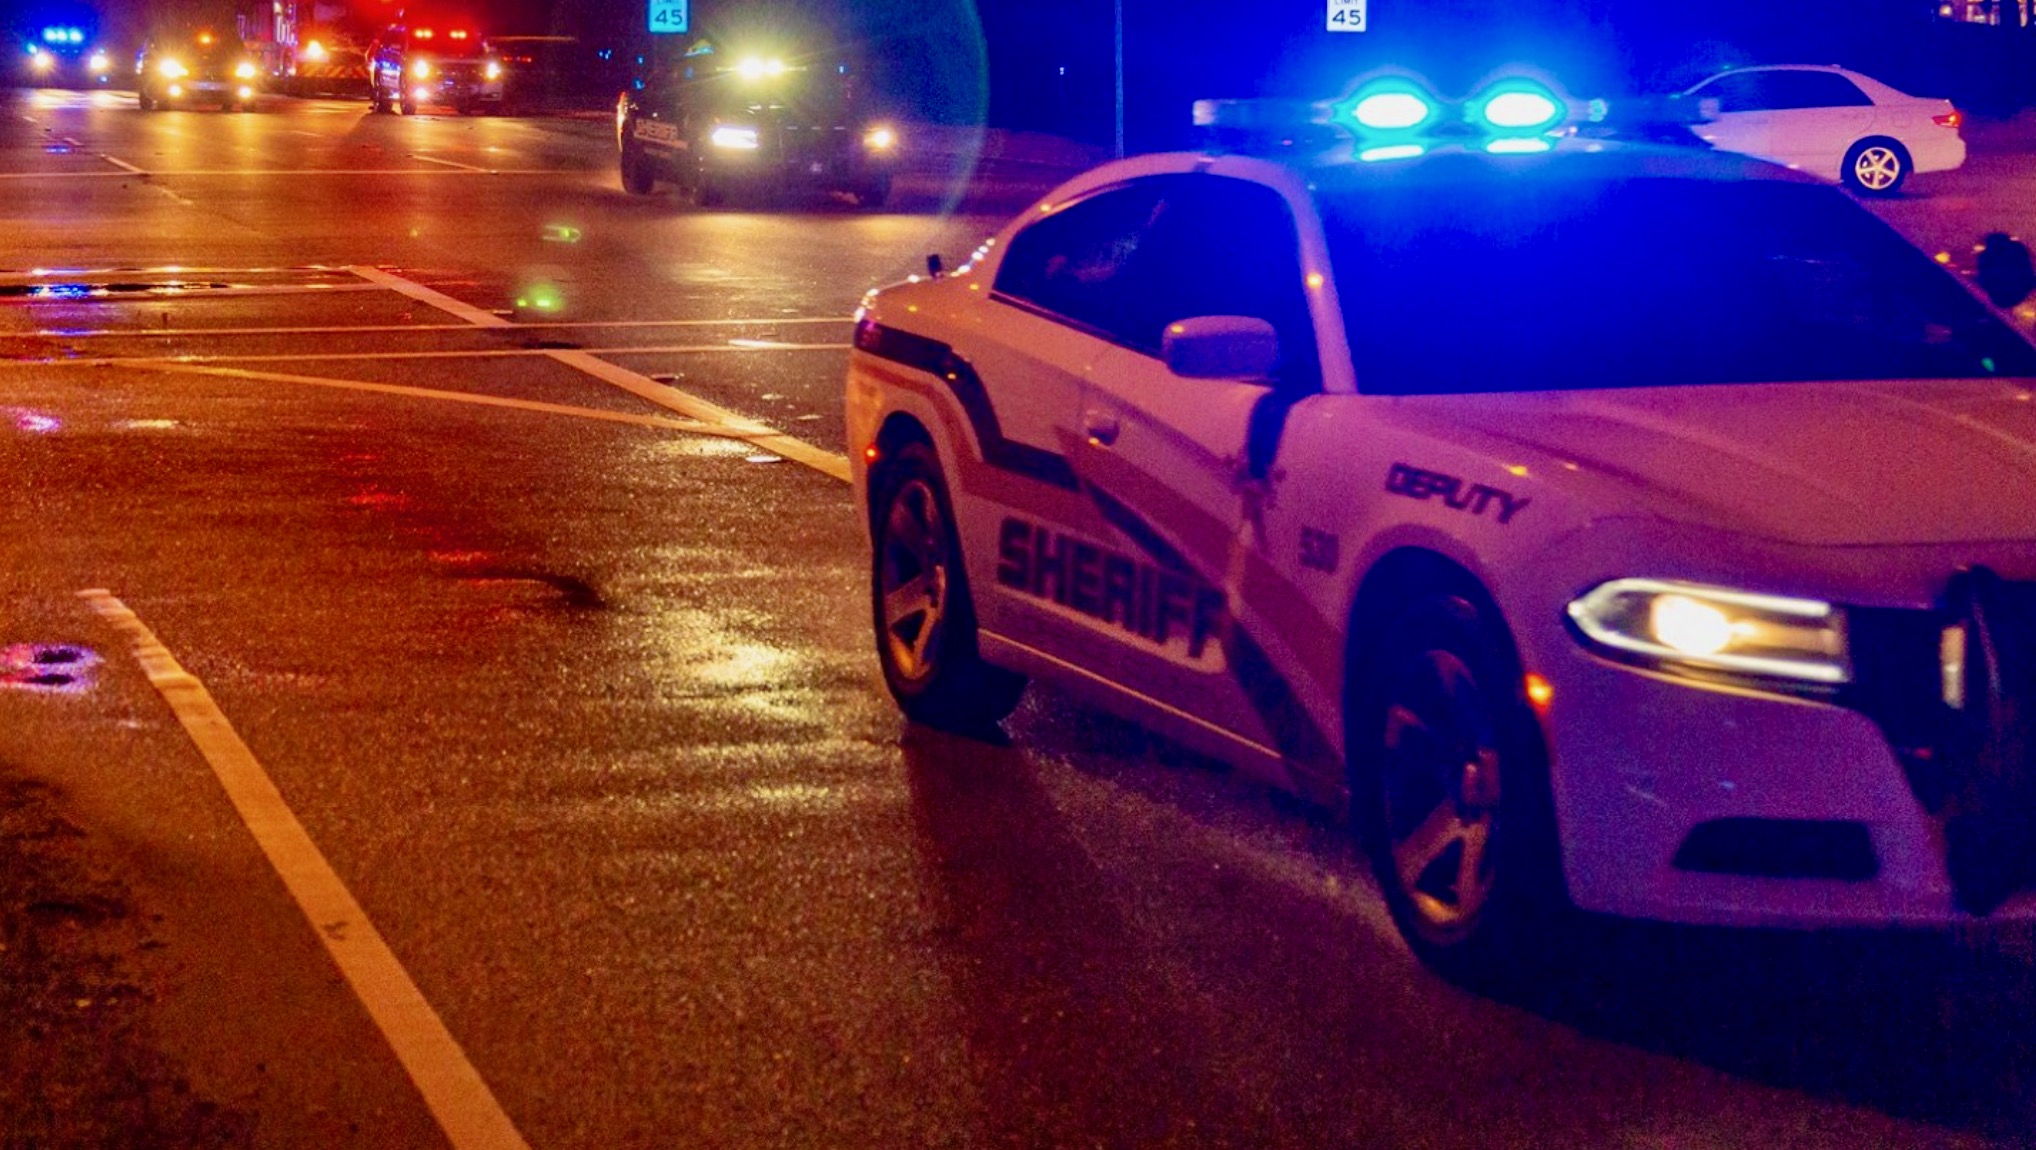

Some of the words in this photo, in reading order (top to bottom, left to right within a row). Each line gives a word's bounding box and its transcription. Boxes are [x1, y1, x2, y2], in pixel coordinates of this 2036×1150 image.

[655, 9, 683, 26] 45
[1332, 9, 1361, 26] 45
[1385, 462, 1533, 525] DEPUTY
[997, 516, 1226, 659] SHERIFF
